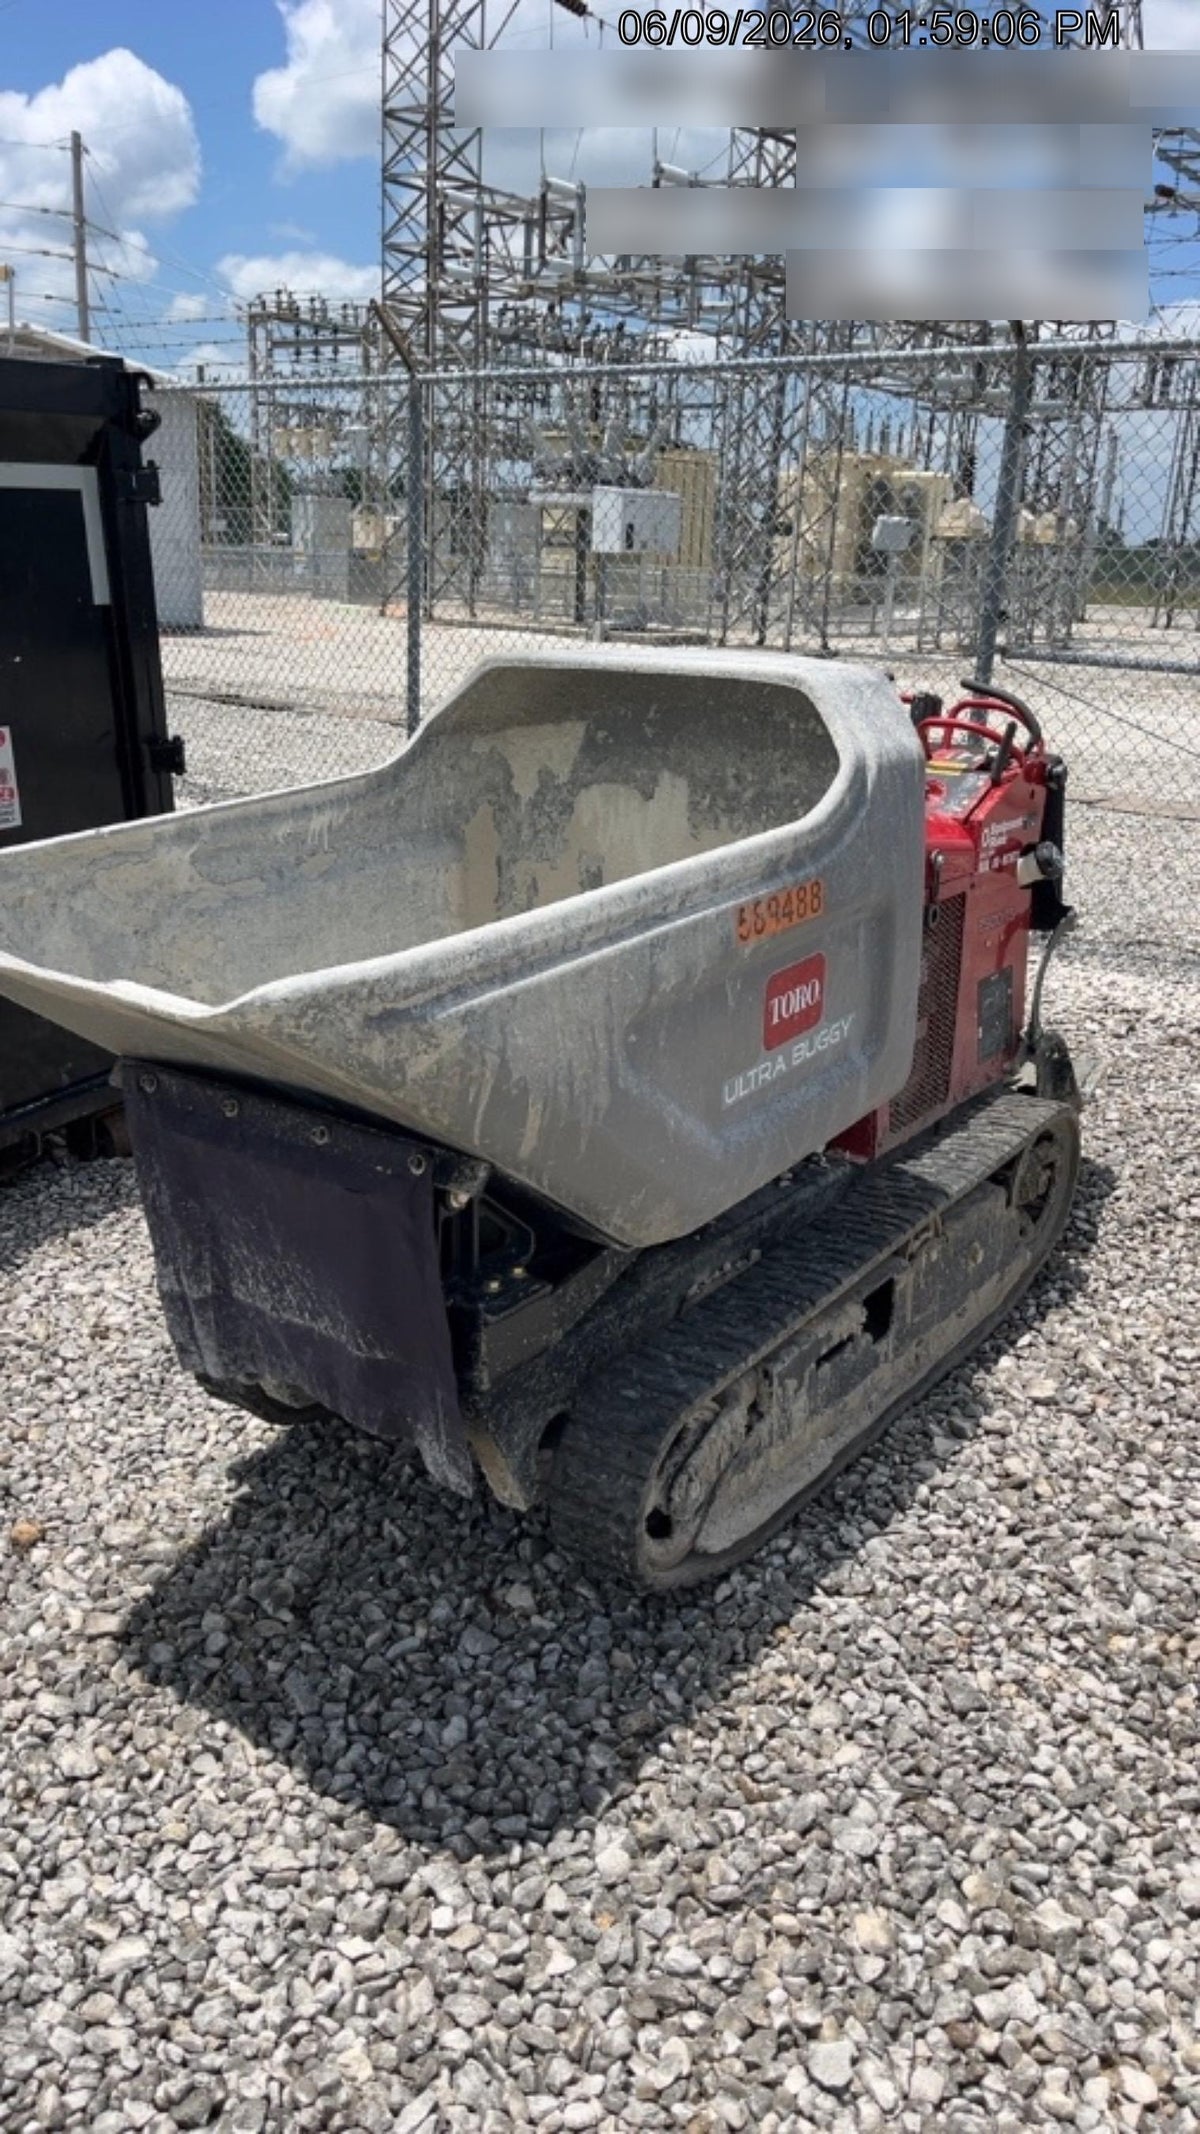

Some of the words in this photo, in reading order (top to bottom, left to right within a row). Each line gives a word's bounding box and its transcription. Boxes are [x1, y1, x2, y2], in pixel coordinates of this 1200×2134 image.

[769, 979, 819, 1025] TORO
[724, 1055, 786, 1104] ULTRA
[792, 1014, 854, 1066] BUGGY
